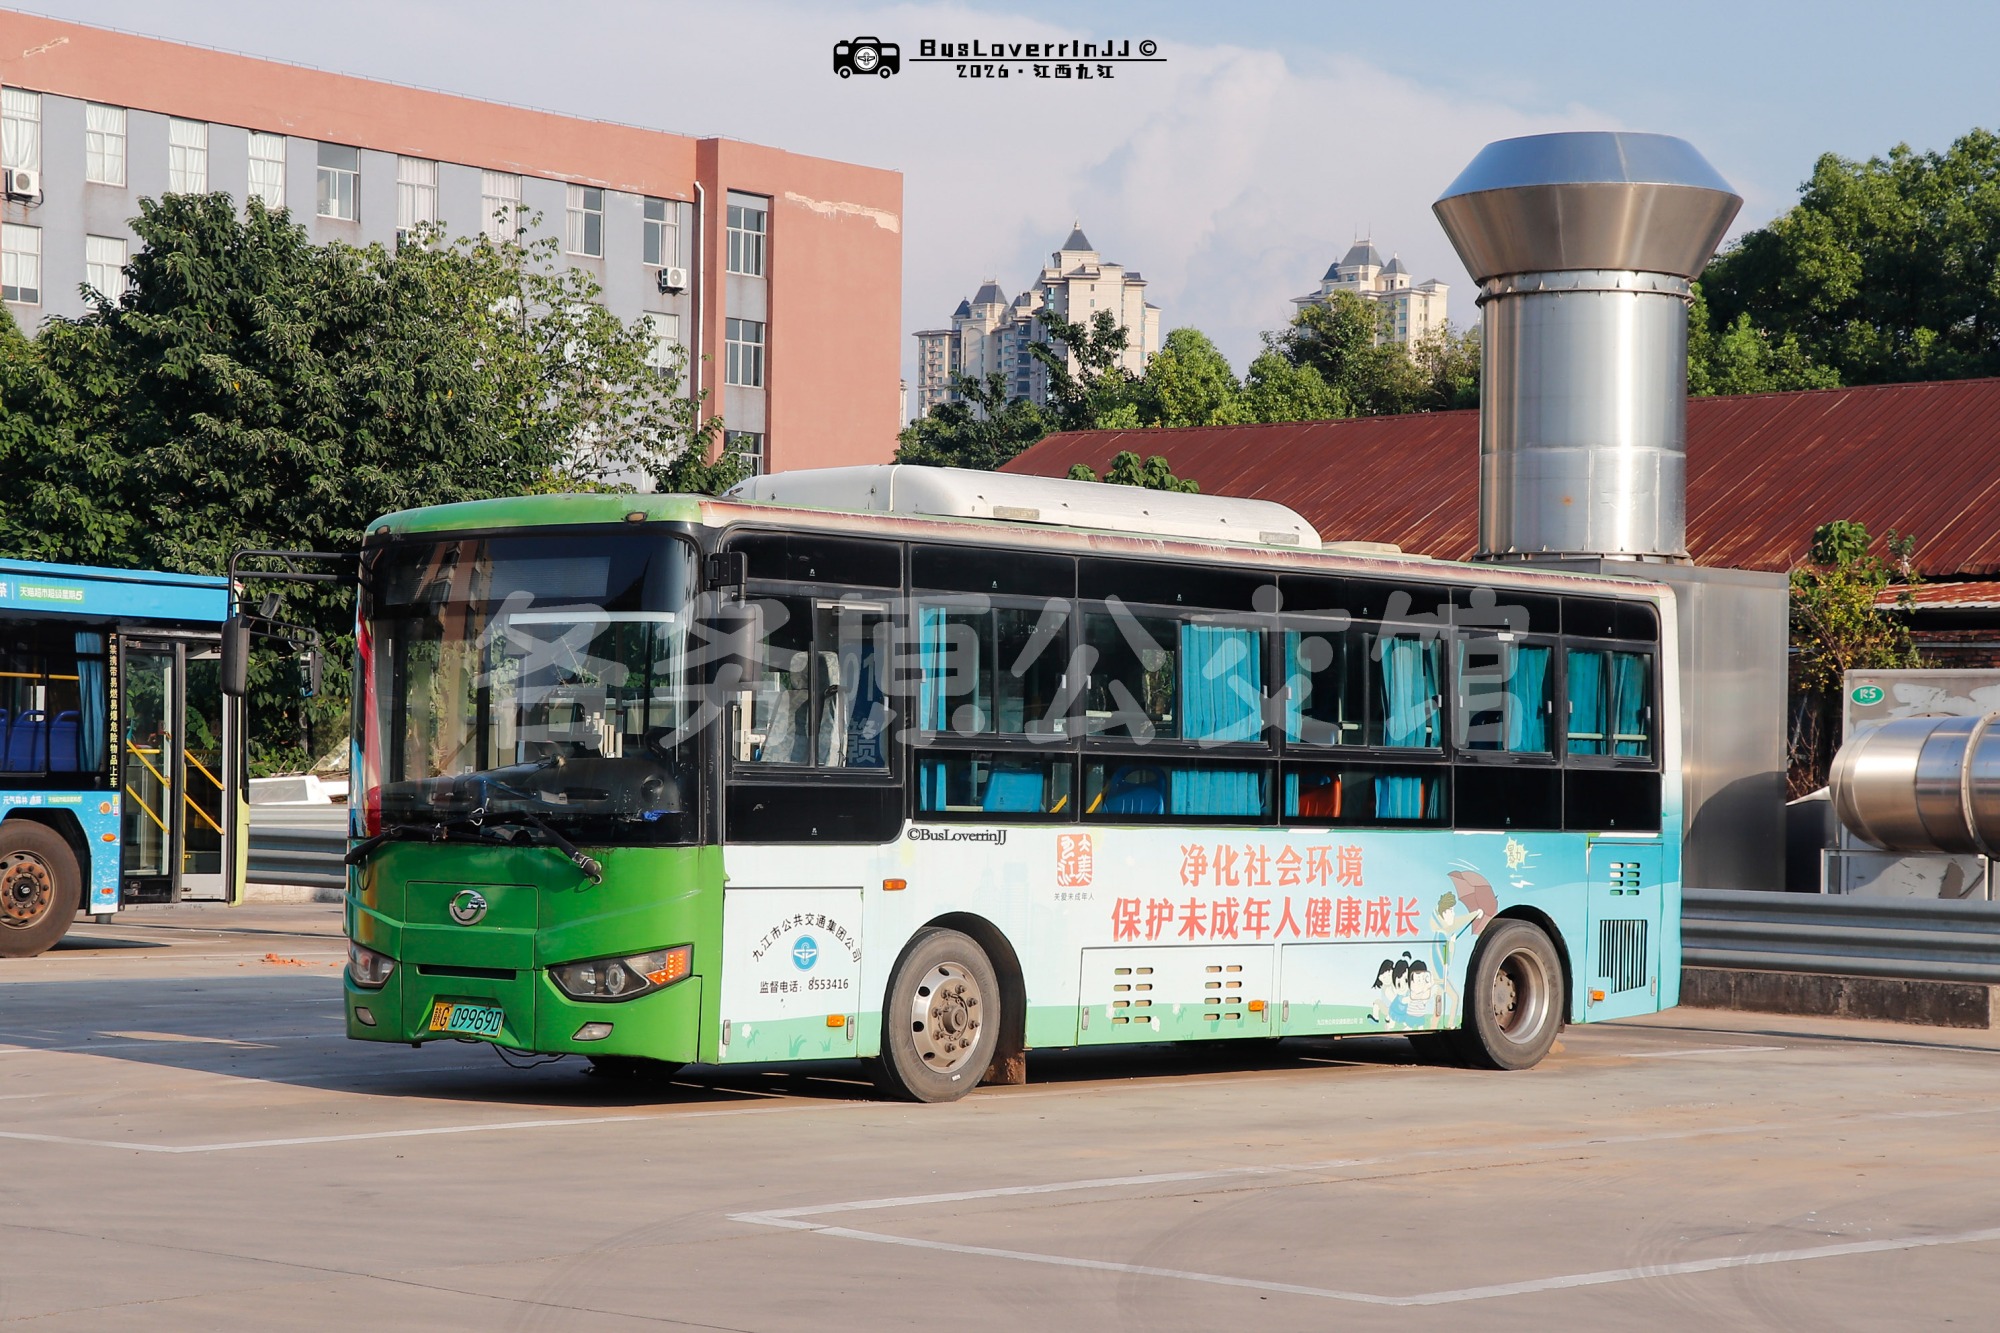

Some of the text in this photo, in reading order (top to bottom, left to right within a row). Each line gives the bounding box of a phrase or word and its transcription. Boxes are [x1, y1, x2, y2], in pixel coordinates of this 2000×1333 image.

[1179, 844, 1365, 887] 净化社会环境
[1054, 892, 1095, 901] 关爱未成年人
[752, 913, 862, 963] 九江市公共交通集团公司
[1111, 896, 1421, 942] 保护未成年人健康成长
[808, 977, 849, 991] 8553416
